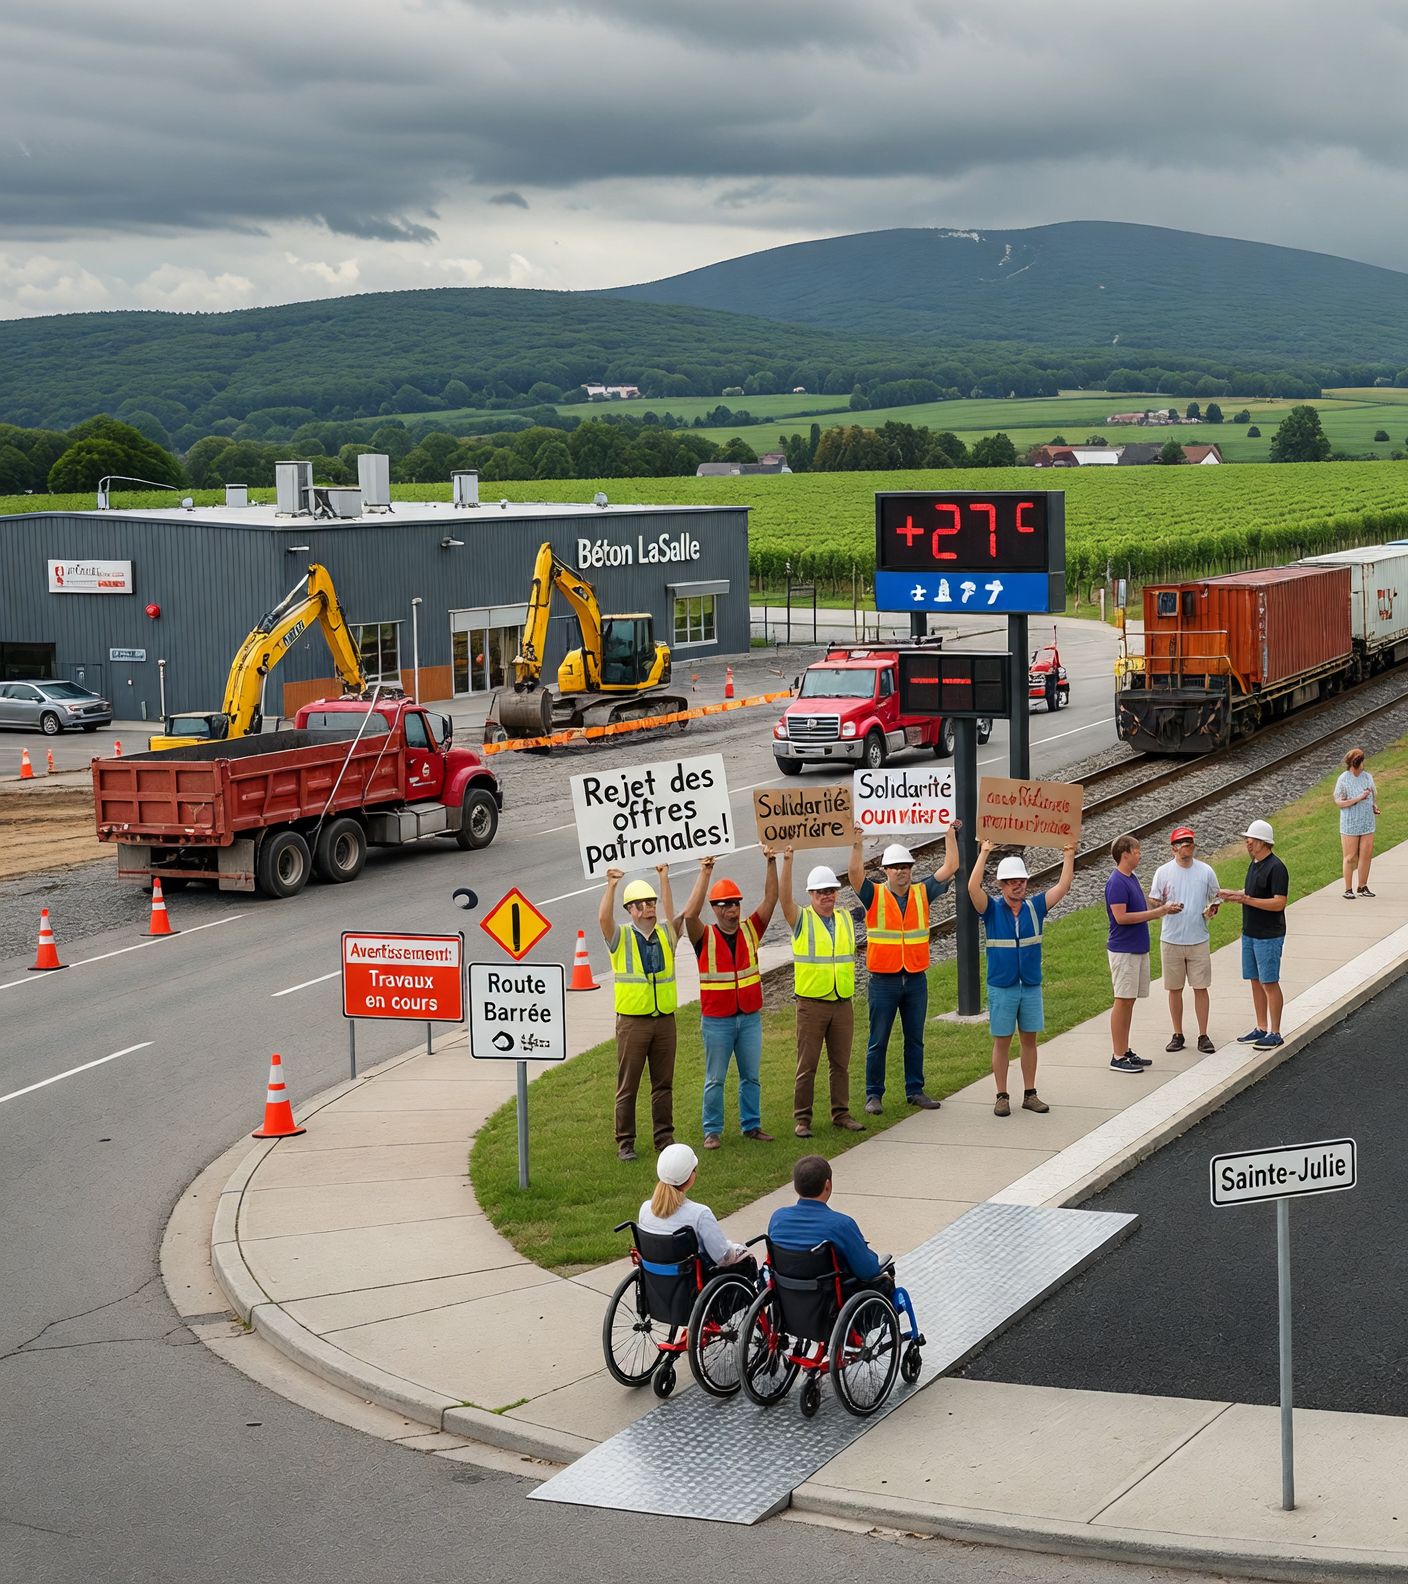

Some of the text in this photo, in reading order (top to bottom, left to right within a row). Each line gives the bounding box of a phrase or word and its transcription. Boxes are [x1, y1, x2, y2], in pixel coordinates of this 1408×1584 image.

[577, 532, 700, 569] Béton LaSalle
[582, 762, 714, 808] Rejet des
[612, 797, 697, 831] offres
[585, 812, 730, 874] patronales!
[368, 969, 434, 989] Travaux
[487, 972, 547, 995] Route
[365, 995, 438, 1012] en cours
[484, 1002, 552, 1023] Barrée
[1221, 1153, 1346, 1192] Sainte-Julie
